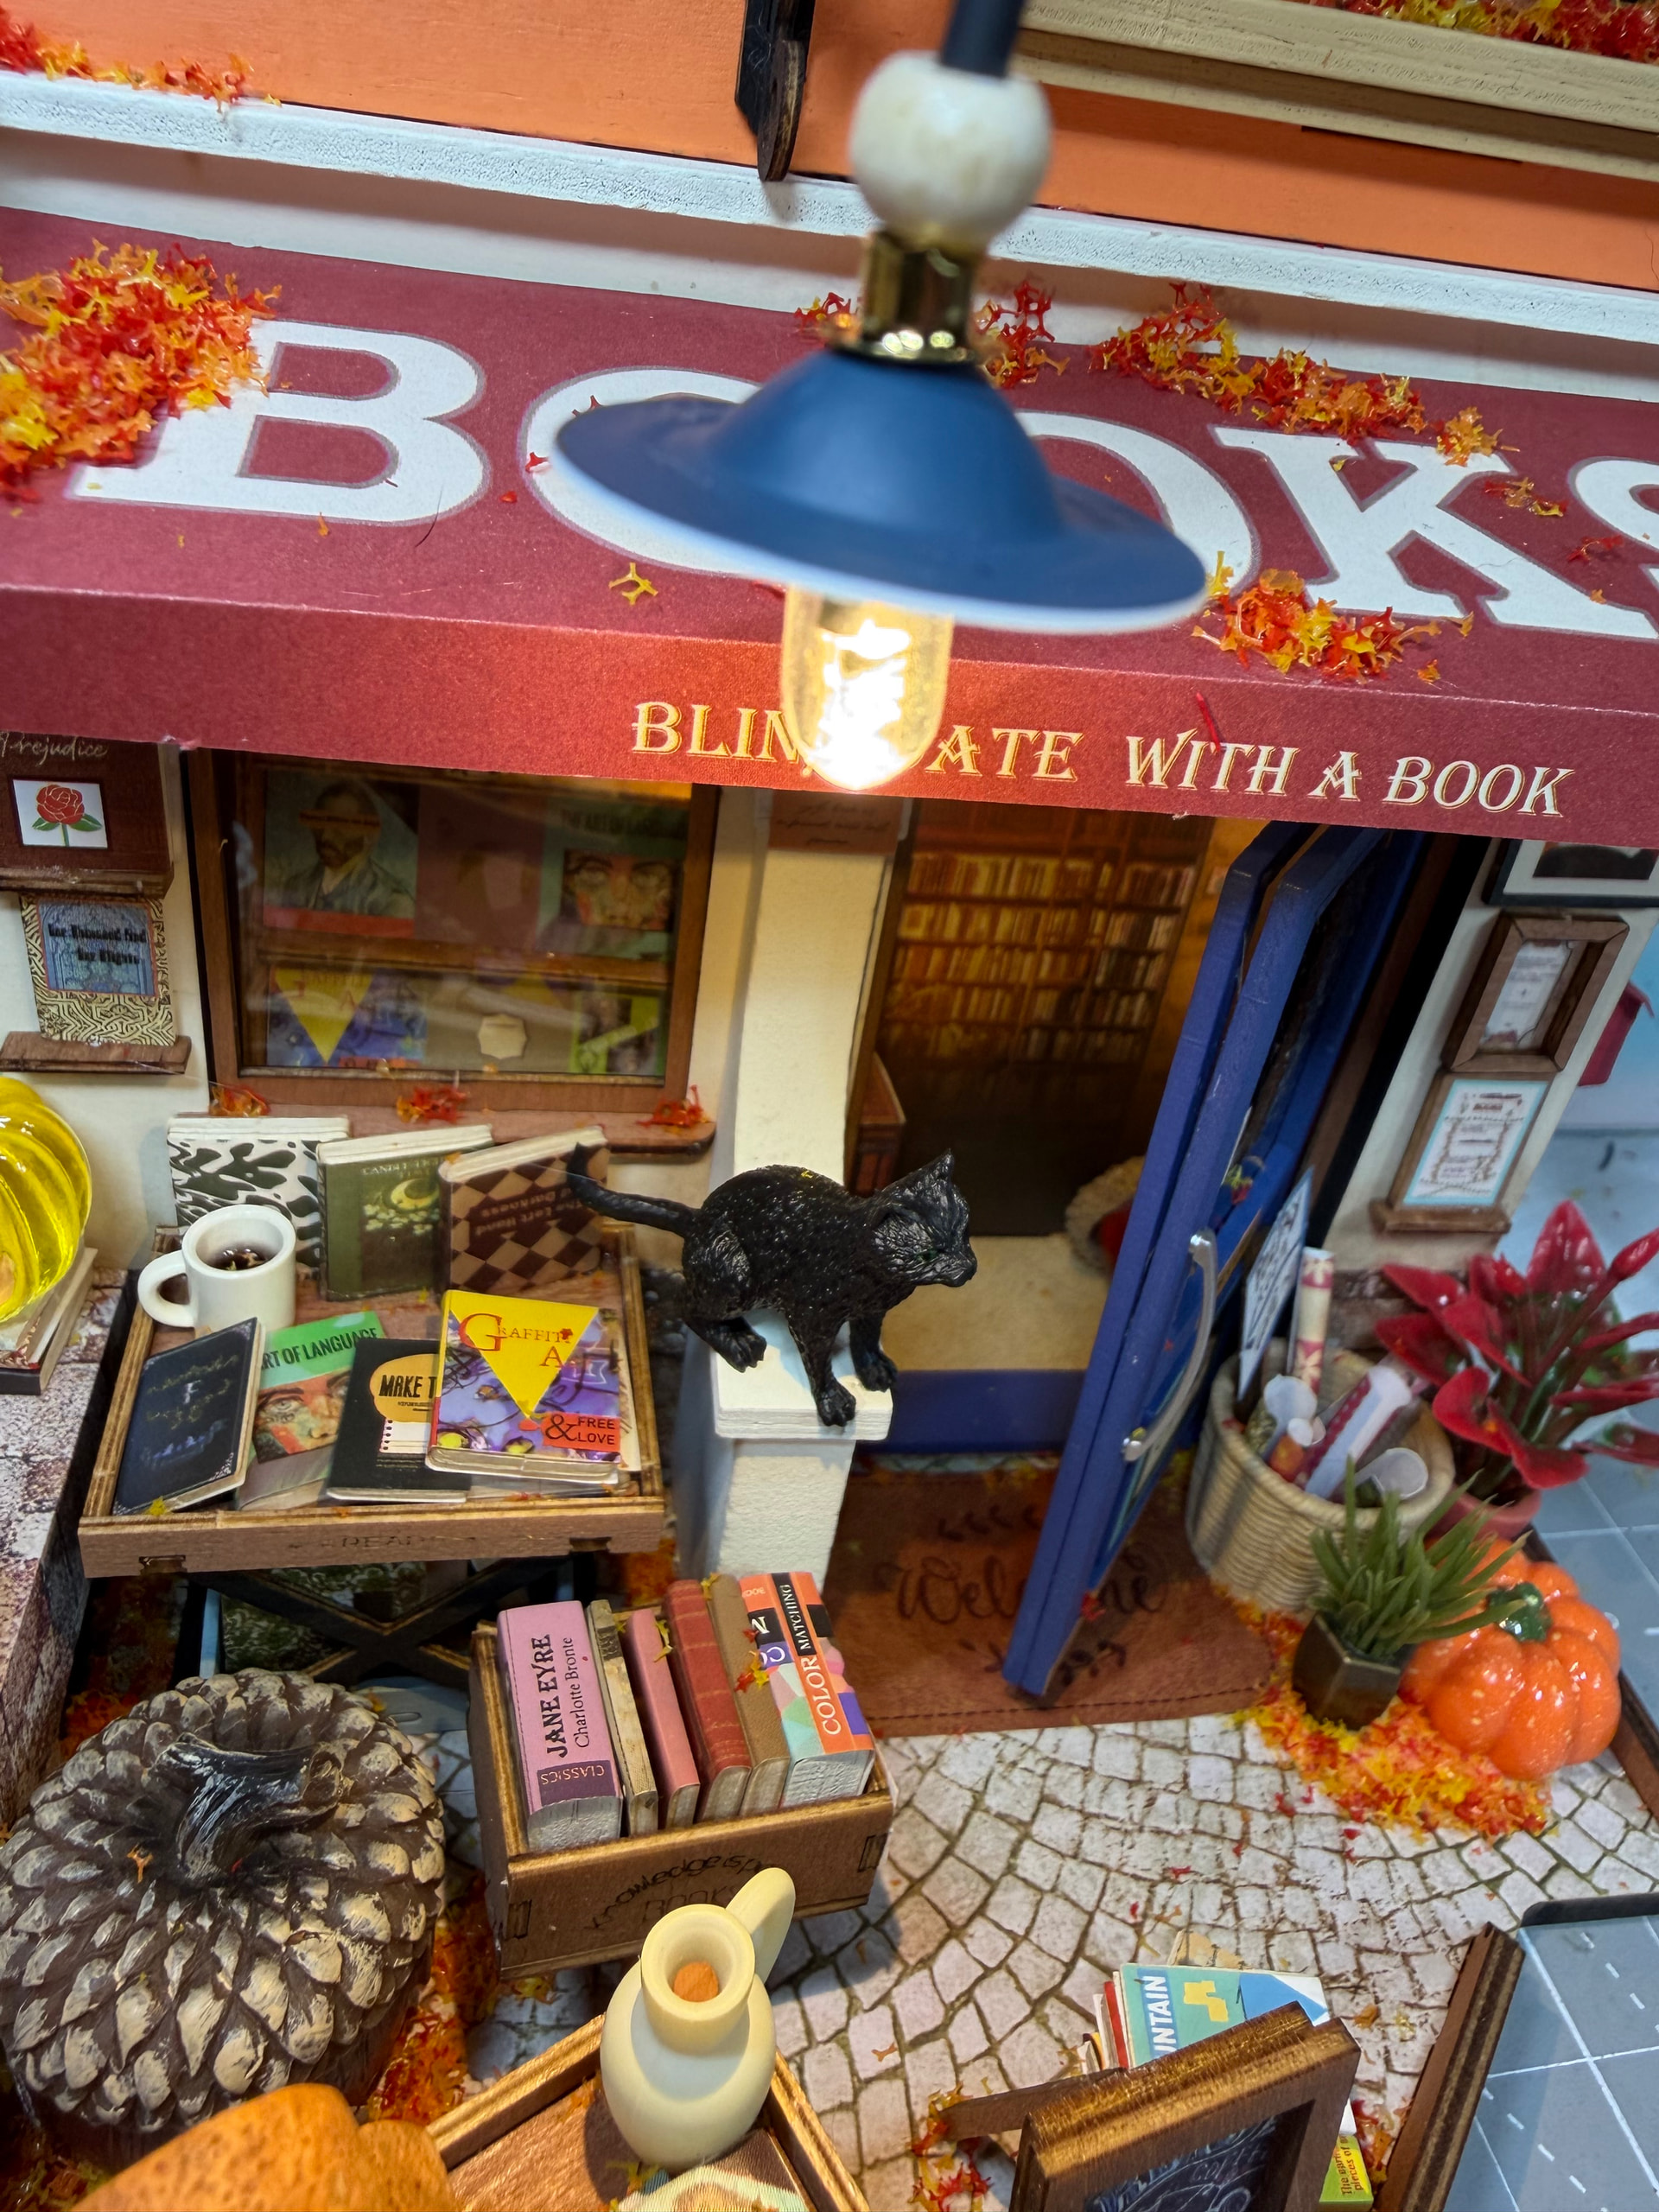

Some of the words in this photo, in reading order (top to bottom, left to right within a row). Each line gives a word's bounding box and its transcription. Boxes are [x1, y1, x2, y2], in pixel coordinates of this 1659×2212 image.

[925, 724, 1085, 782] ATE
[1125, 728, 1300, 797] WITH
[1307, 750, 1363, 802] A
[1382, 755, 1575, 817] BOOK
[282, 1345, 301, 1365] OF
[378, 1374, 423, 1398] MAKE
[577, 1416, 615, 1430] FREE
[577, 1432, 615, 1446] LOVE
[779, 1584, 812, 1650] MATCHING
[531, 1634, 559, 1694] EYRE
[563, 1637, 580, 1681] Bronte
[569, 1683, 590, 1748] Charlotte
[800, 1655, 842, 1735] COLOR
[540, 1695, 568, 1758] JANE
[540, 1764, 606, 1785] CLASSICS
